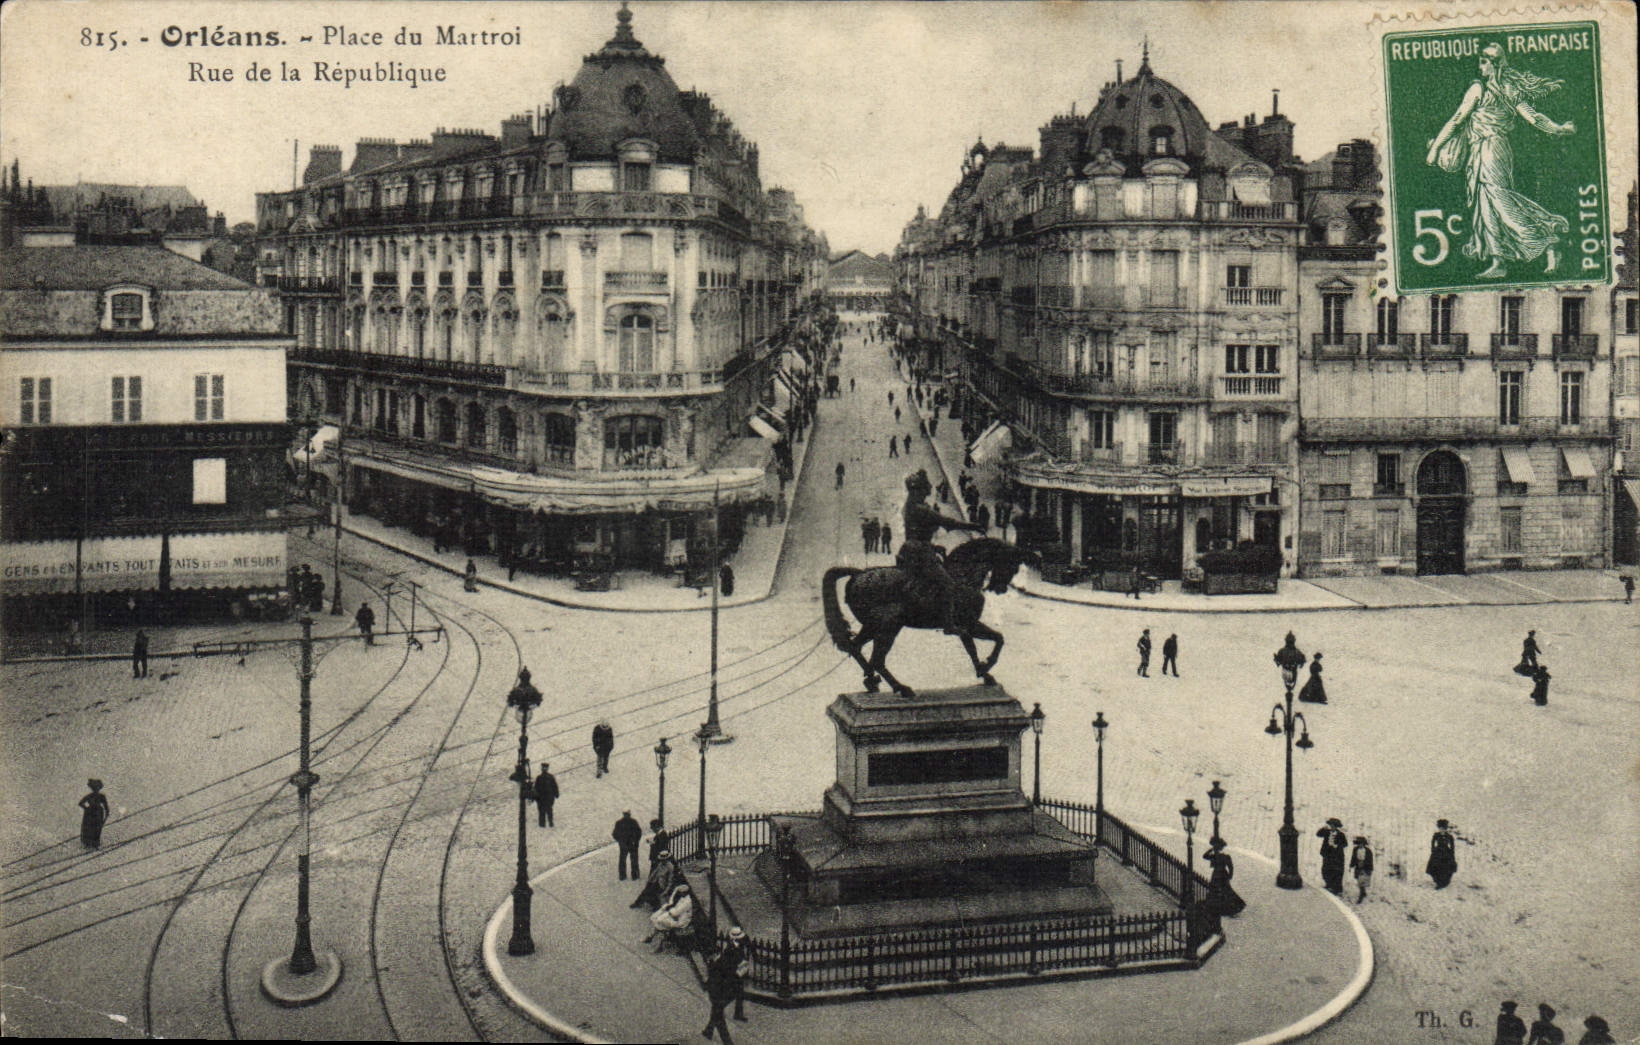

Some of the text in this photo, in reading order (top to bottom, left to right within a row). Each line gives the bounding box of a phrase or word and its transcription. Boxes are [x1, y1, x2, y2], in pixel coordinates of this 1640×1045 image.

[1391, 30, 1590, 62] REPUBLIQUE FRANÇAISE
[1578, 183, 1600, 270] POSTES
[4, 564, 40, 578] GENS
[125, 559, 154, 571] TOUT
